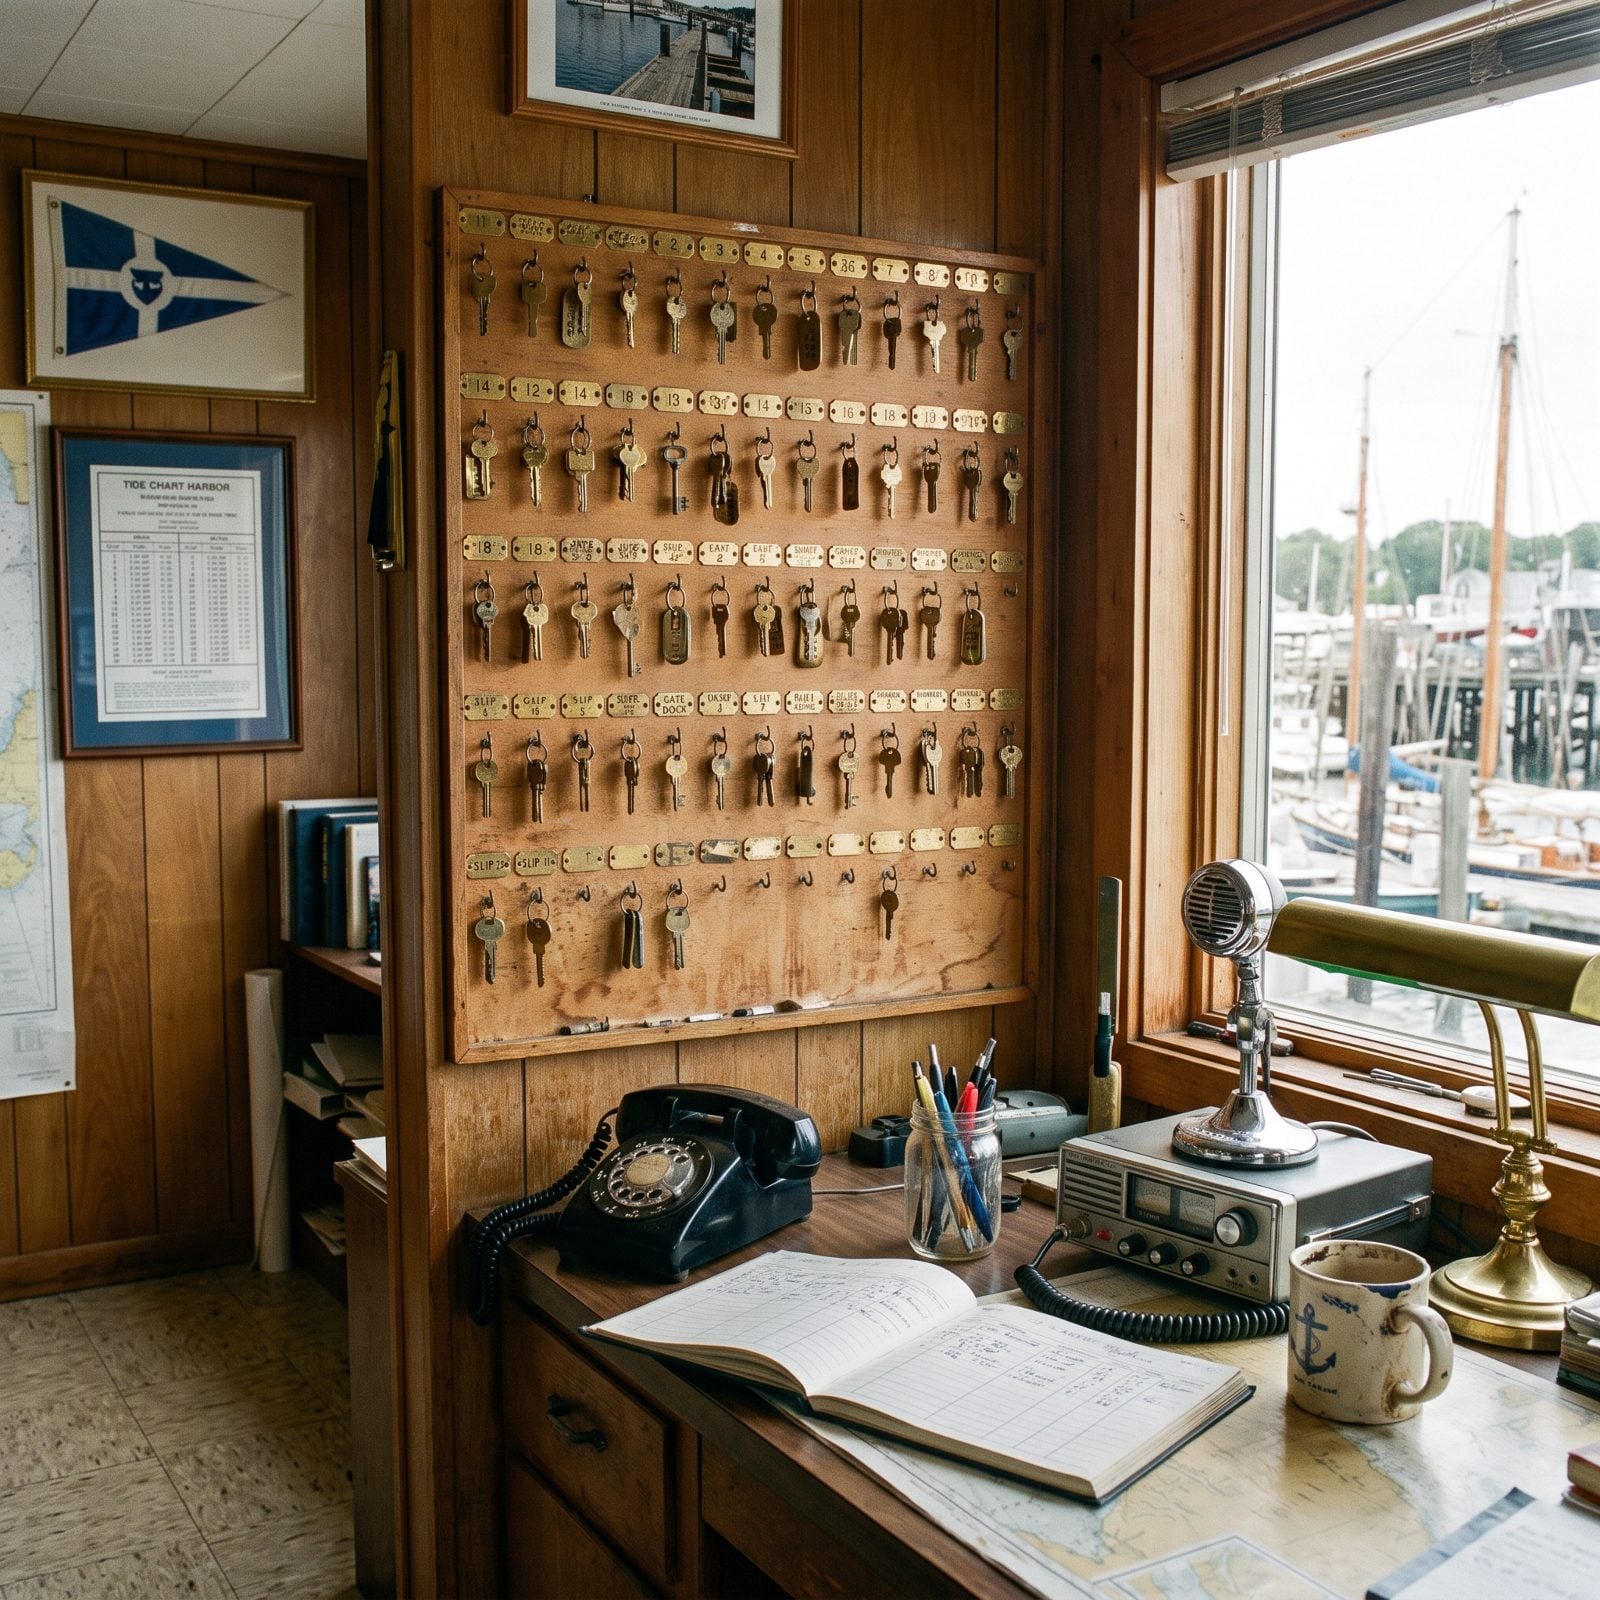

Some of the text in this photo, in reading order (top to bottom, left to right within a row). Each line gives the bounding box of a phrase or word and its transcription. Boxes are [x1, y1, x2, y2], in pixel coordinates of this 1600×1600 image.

[670, 238, 678, 250] 2
[716, 244, 724, 256] 3
[760, 249, 767, 261] 4
[804, 255, 811, 267] 5
[887, 264, 894, 276] 7
[928, 269, 936, 282] 8
[476, 379, 490, 393] 14
[527, 383, 540, 397] 12
[575, 386, 587, 400] 14
[622, 390, 634, 403] 18
[668, 393, 680, 407] 13
[758, 399, 770, 411] 14
[843, 407, 854, 419] 16
[884, 409, 896, 421] 18
[123, 480, 231, 492] TIDE CHART HARBOR
[478, 541, 492, 554] 18
[529, 543, 542, 555] 18
[716, 554, 723, 563] 2
[663, 695, 685, 704] GATE
[662, 705, 687, 715] DOCK
[473, 860, 494, 871] SLIP
[522, 858, 540, 868] SLIP
